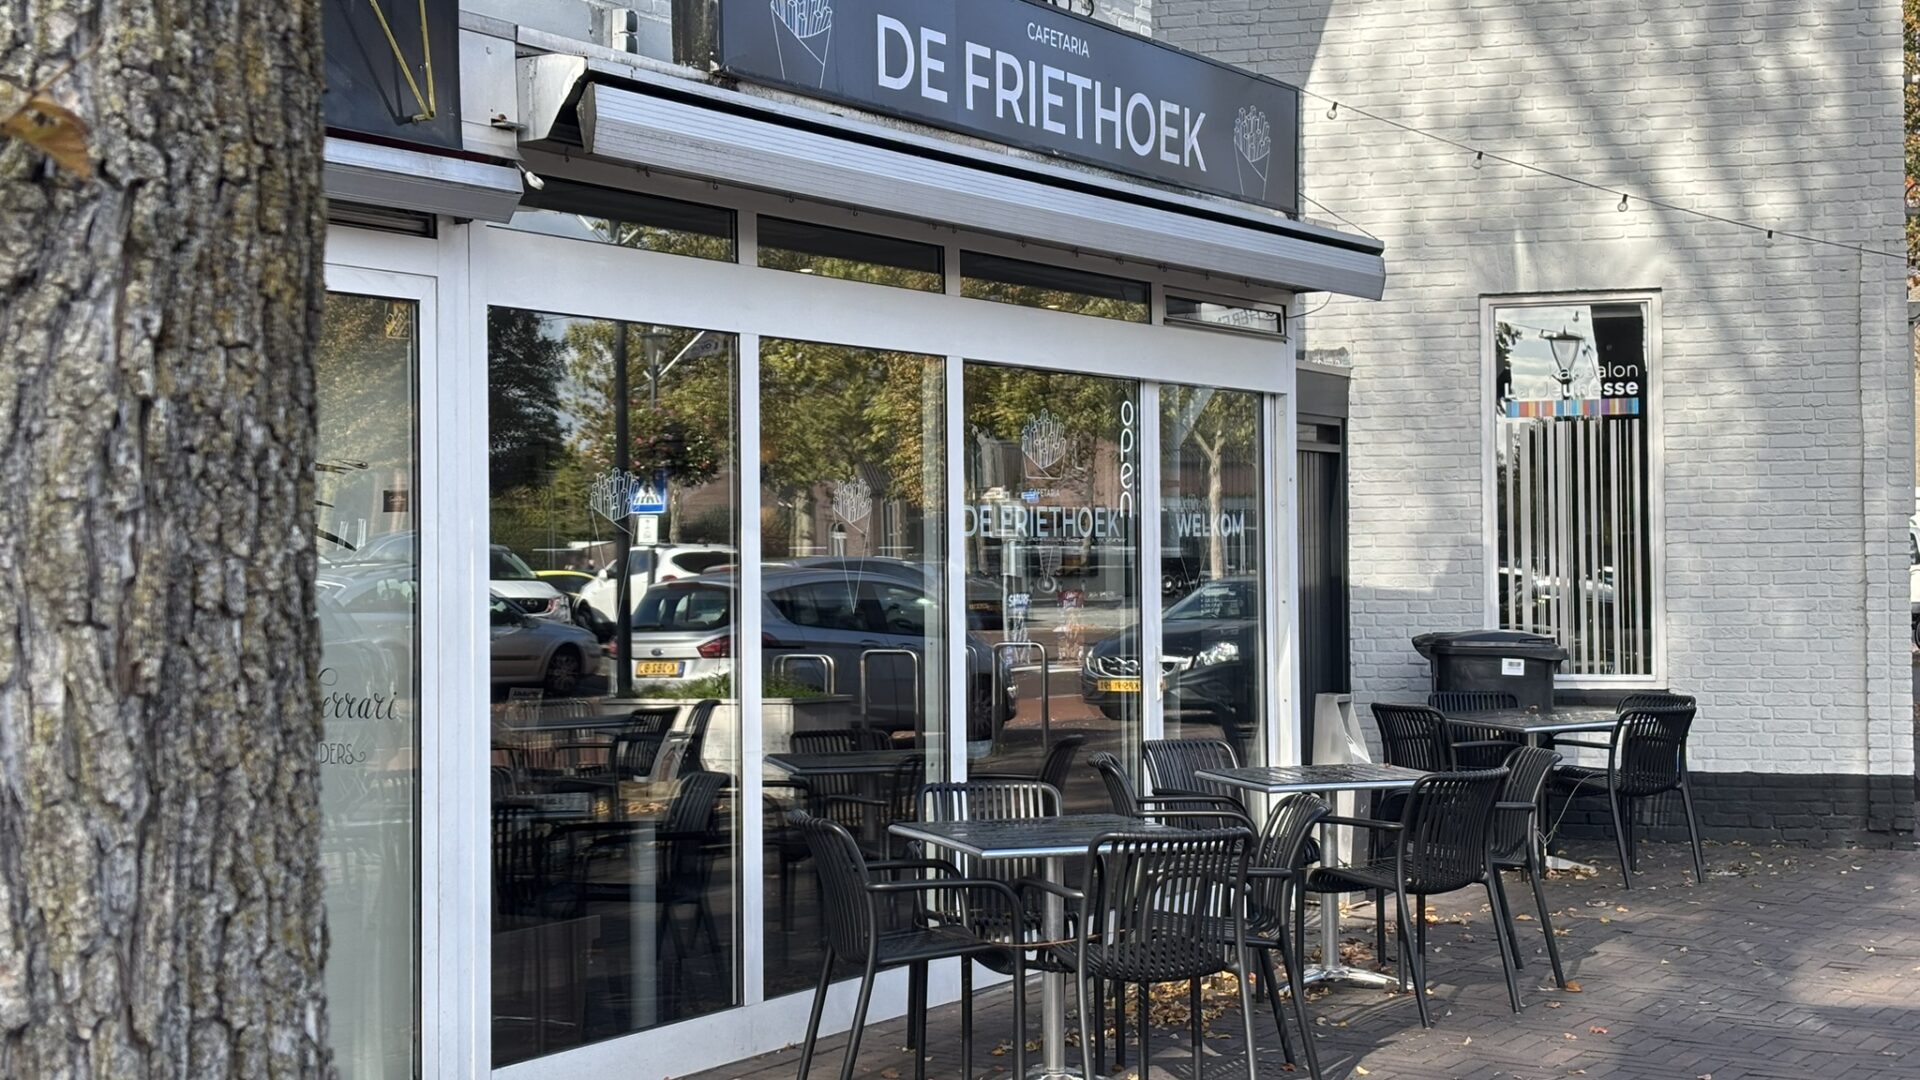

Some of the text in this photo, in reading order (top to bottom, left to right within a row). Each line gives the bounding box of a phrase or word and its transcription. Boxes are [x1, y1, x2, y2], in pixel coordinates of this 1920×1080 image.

[1027, 21, 1090, 59] CAFETARIA
[876, 14, 1207, 173] DE FRIETHOEK
[1119, 400, 1134, 519] open
[963, 504, 1121, 537] DE FRIETHOEK
[1175, 511, 1245, 537] WELKOM
[318, 682, 398, 720] errari
